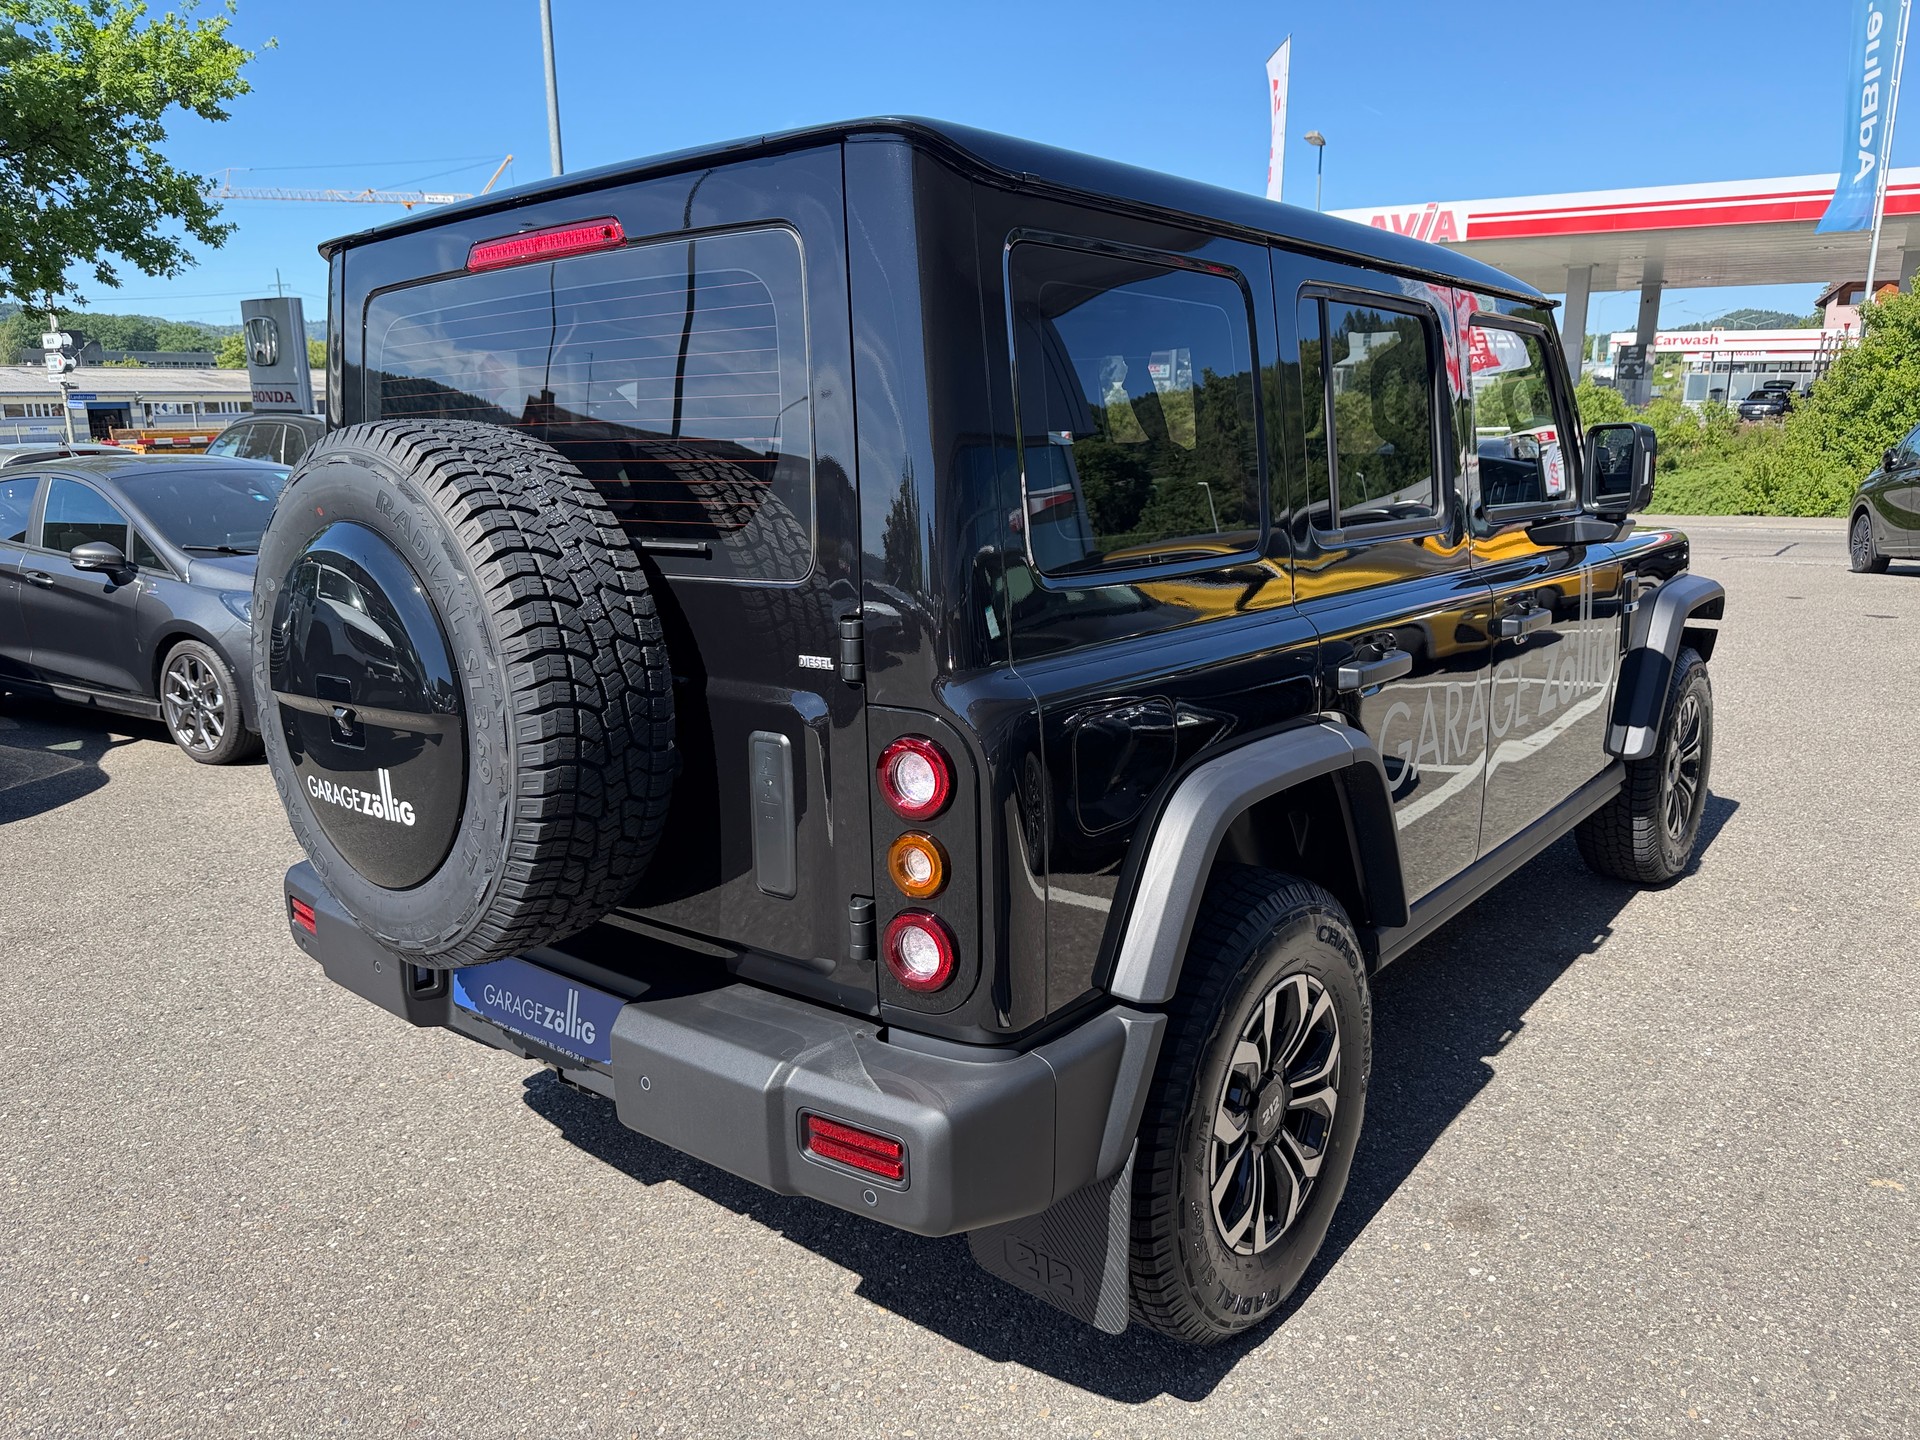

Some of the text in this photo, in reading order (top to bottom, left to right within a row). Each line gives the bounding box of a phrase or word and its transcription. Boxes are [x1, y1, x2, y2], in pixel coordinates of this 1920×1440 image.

[1654, 334, 1719, 346] Carwash
[252, 391, 296, 403] HONDA
[375, 488, 466, 636] RADIAL
[798, 654, 834, 671] DIESEL
[1262, 1095, 1280, 1126] 212
